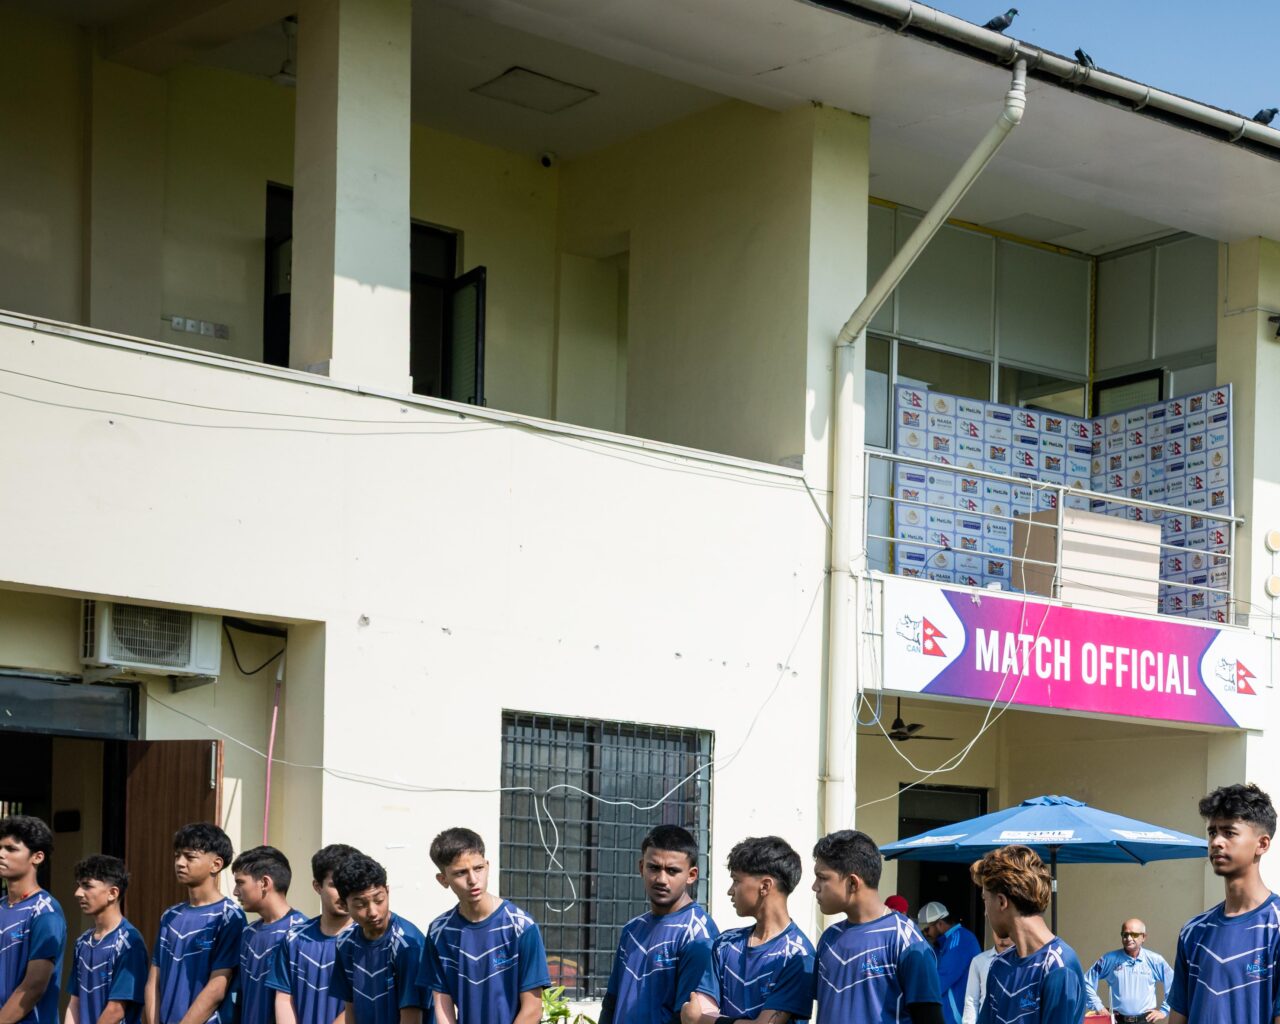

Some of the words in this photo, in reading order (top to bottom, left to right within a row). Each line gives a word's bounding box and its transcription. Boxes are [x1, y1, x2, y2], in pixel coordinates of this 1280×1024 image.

[906, 643, 922, 653] CAN
[975, 627, 1071, 682] MATCH
[1080, 641, 1197, 696] OFFICIAL
